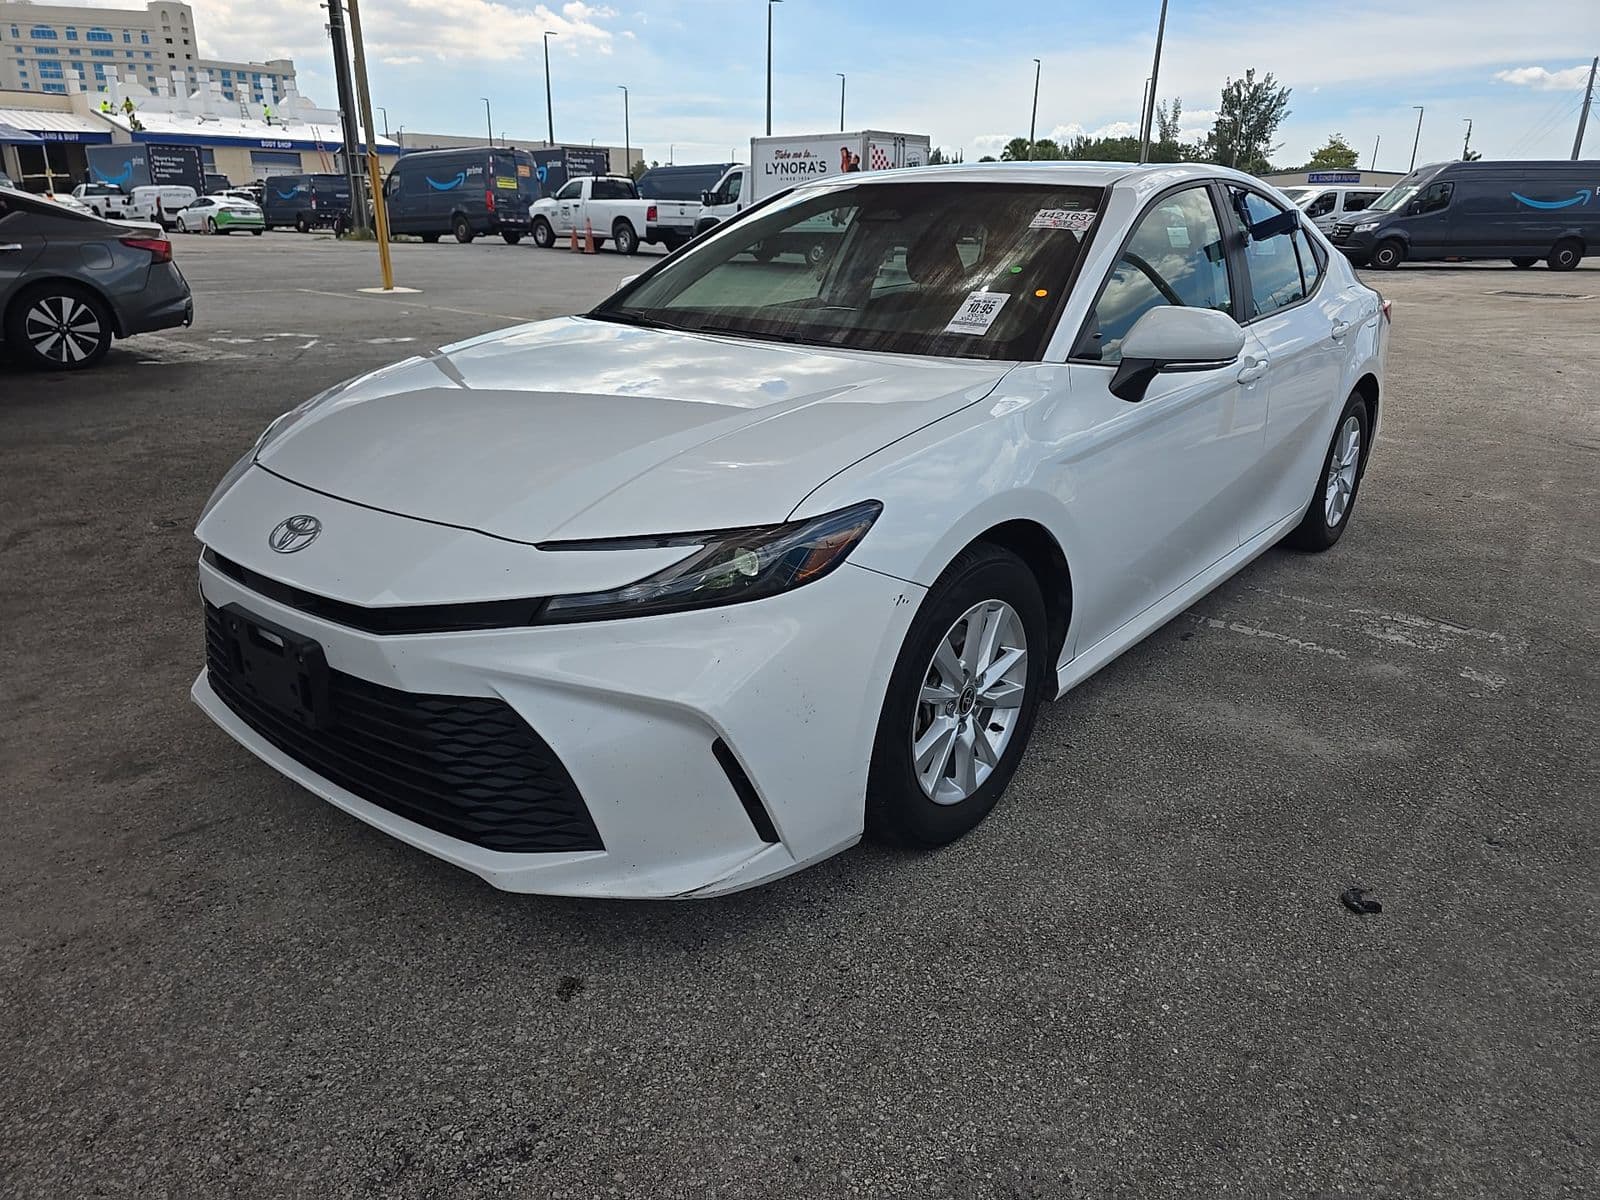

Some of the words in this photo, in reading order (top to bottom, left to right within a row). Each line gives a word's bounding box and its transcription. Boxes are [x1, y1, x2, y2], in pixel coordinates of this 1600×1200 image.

[775, 150, 791, 160] Take
[765, 161, 826, 175] LYNORA'S
[1038, 211, 1096, 221] 4421637
[967, 303, 995, 315] 10:95
